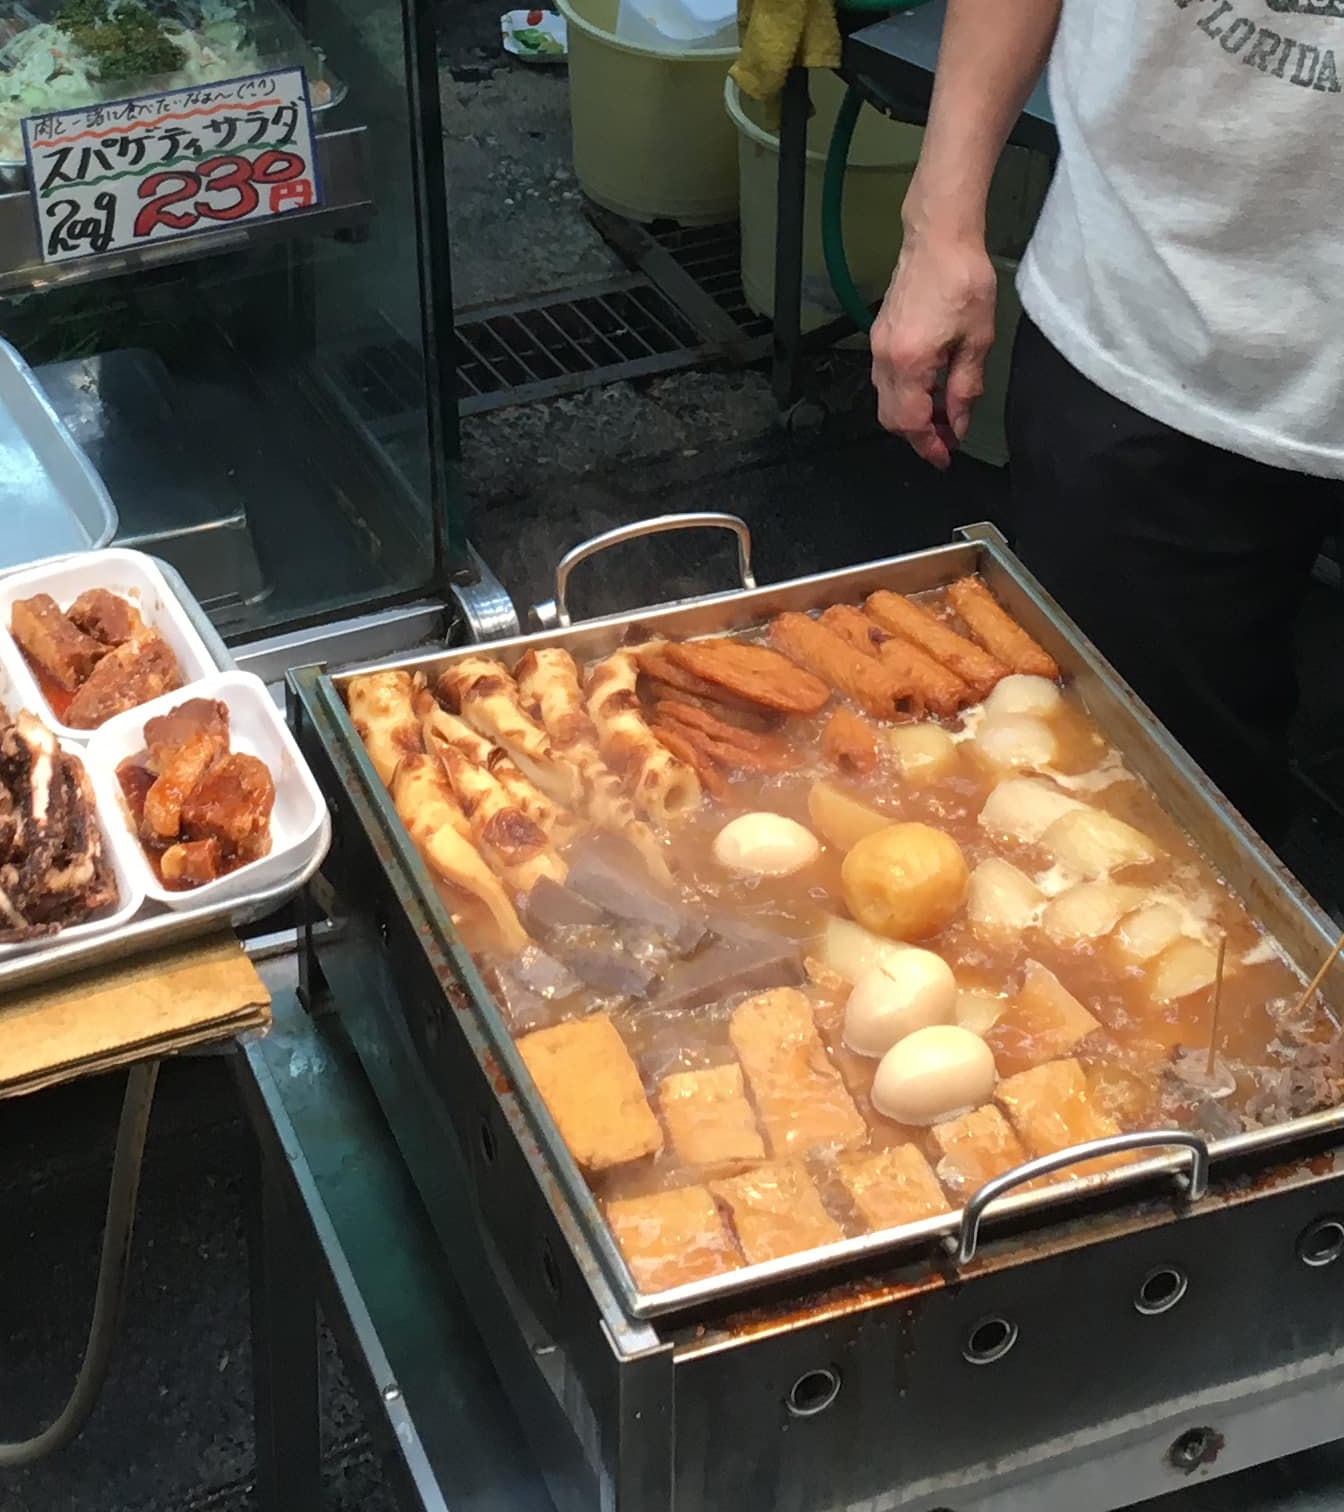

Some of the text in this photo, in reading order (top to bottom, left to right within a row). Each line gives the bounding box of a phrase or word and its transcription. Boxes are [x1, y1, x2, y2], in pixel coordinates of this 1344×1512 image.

[40, 95, 307, 190] スパゲティサラダ
